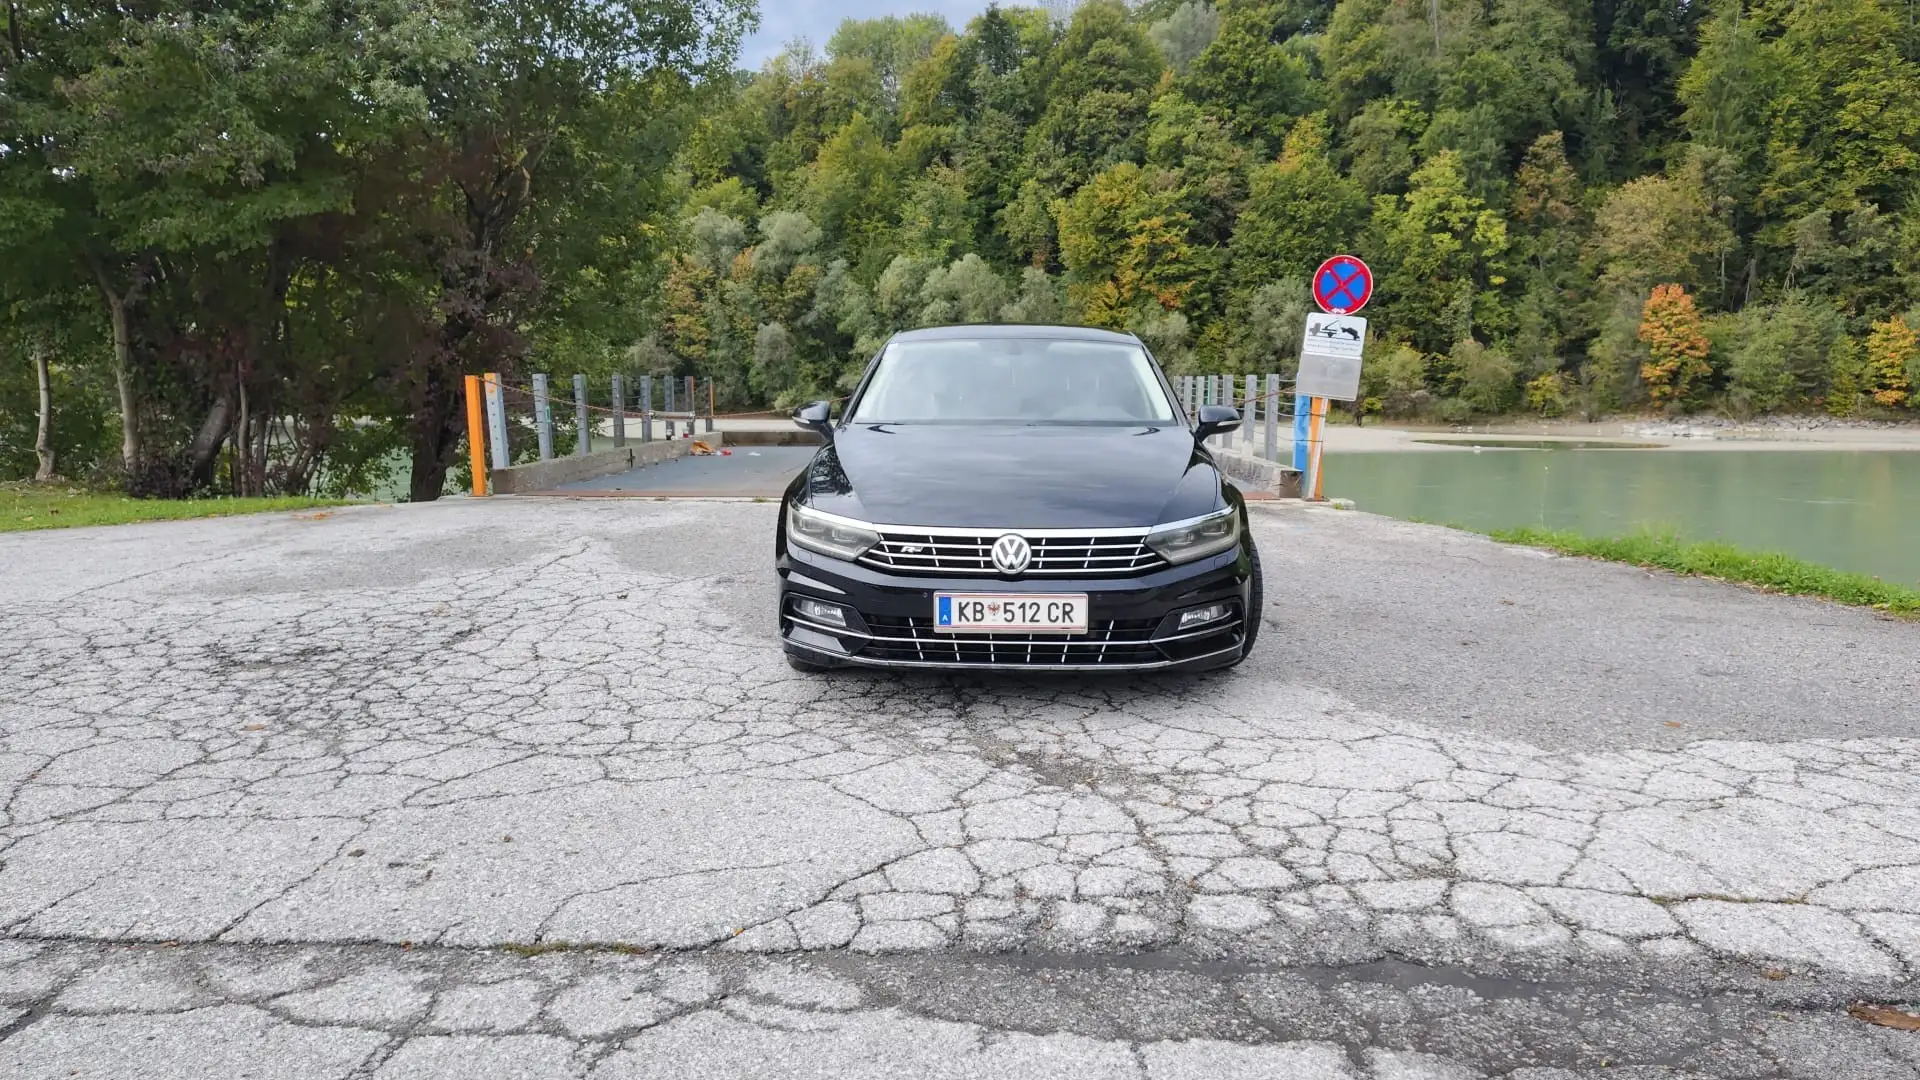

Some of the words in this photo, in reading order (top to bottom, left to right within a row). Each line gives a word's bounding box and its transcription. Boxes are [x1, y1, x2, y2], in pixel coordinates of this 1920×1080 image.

[958, 601, 985, 622] KB
[1003, 602, 1040, 623] 512
[1047, 602, 1074, 623] CR
